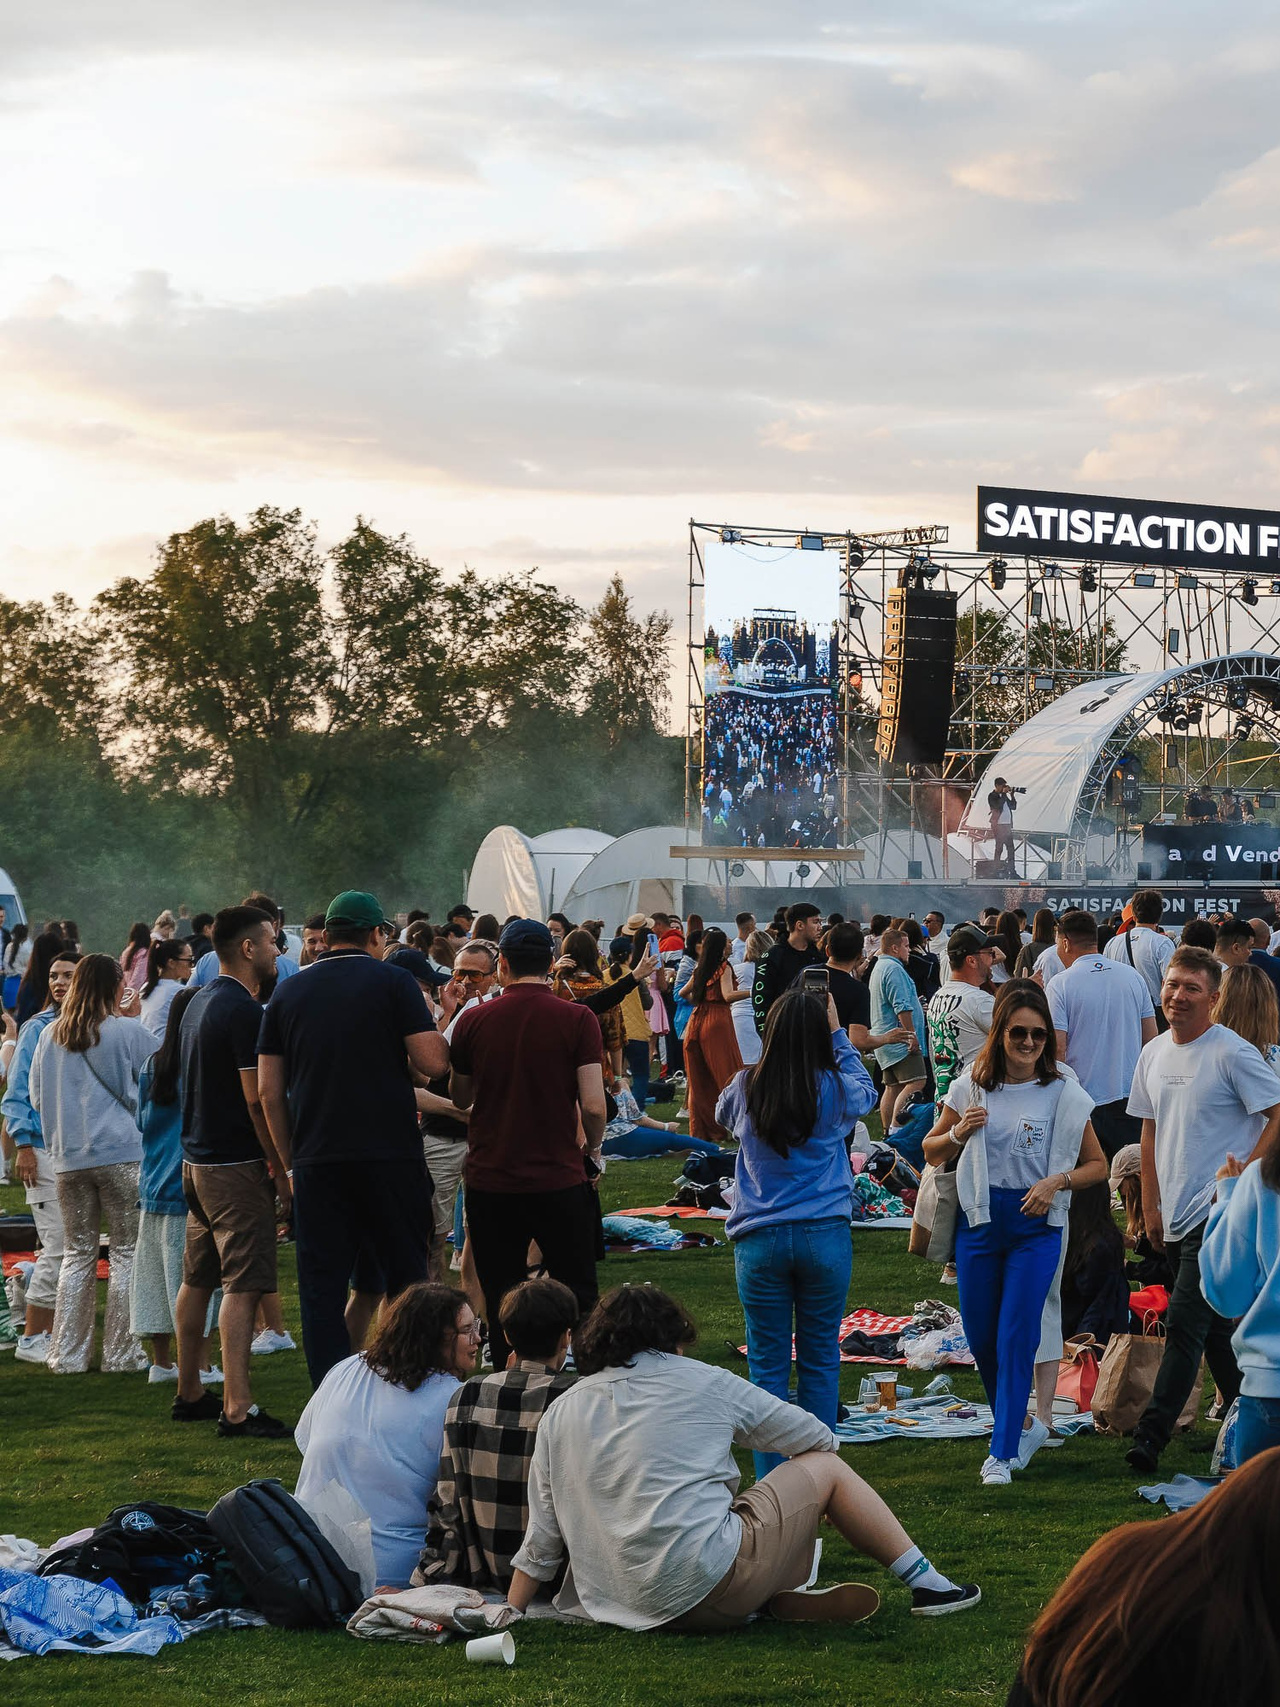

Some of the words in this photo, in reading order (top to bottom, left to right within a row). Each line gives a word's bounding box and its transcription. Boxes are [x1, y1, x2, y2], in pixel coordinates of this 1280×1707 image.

[984, 502, 1250, 556] SATISFACTION
[1046, 897, 1185, 913] SATISFAON
[1194, 898, 1241, 913] FEST
